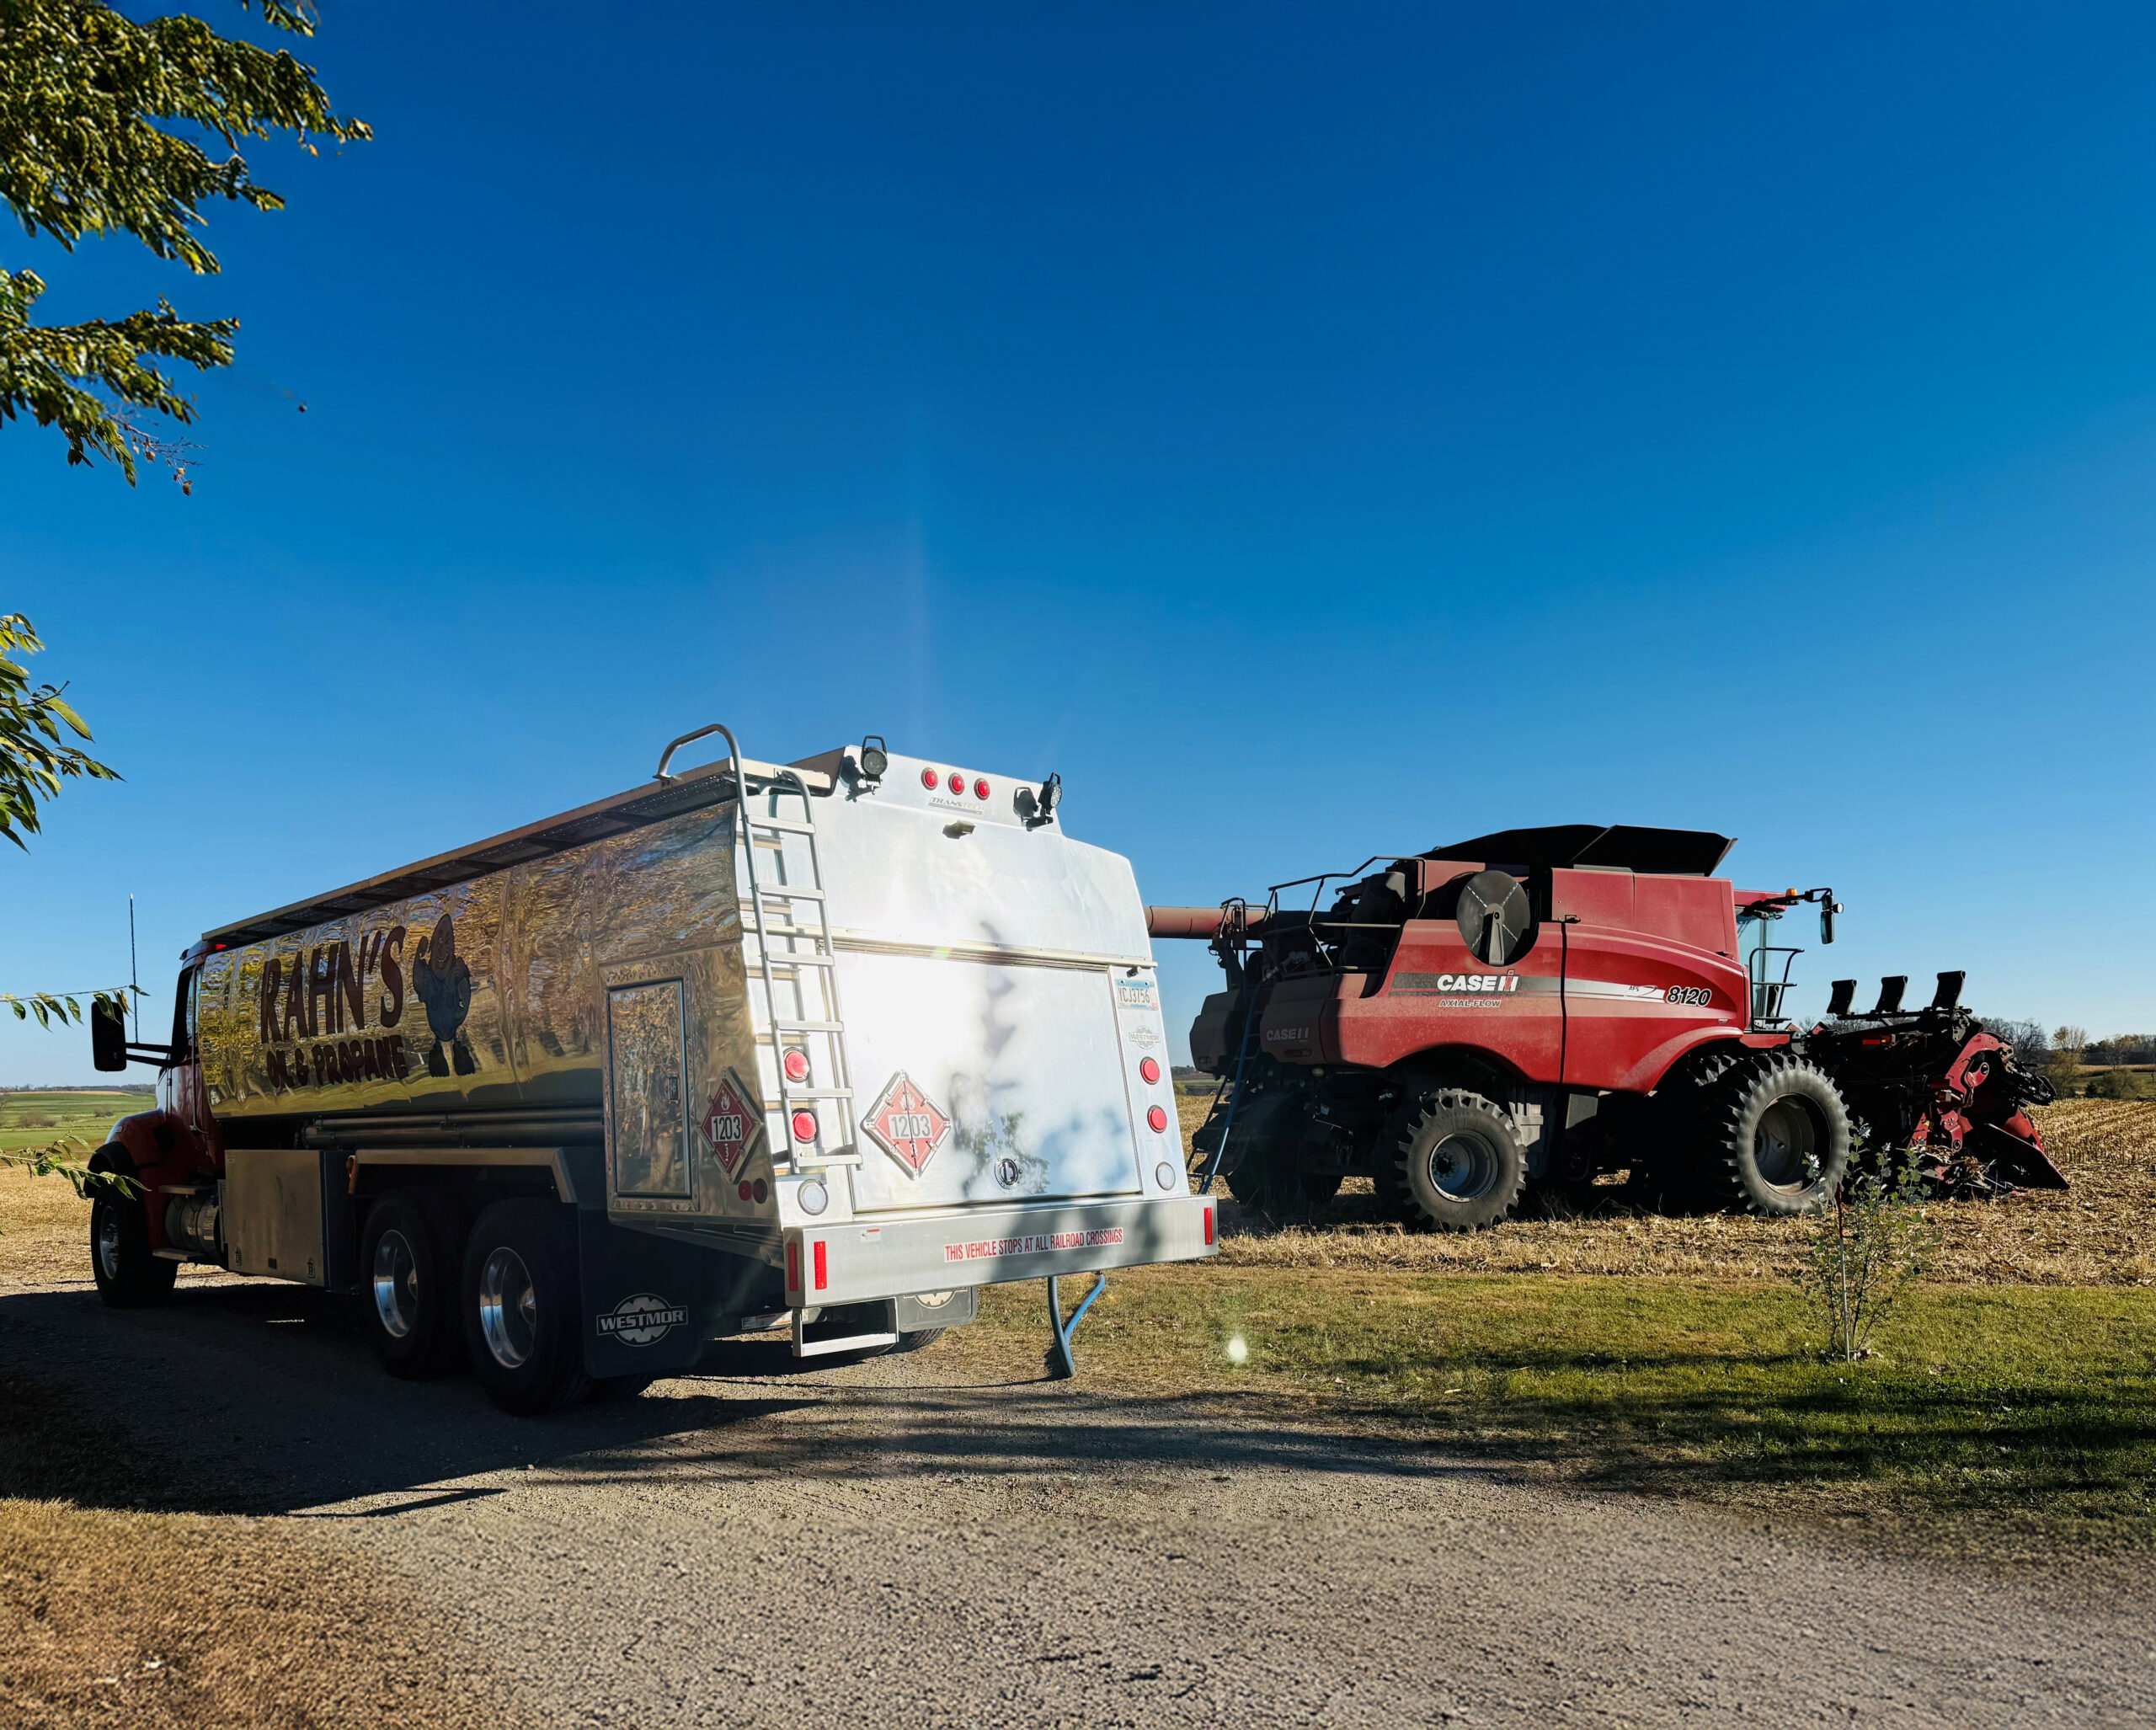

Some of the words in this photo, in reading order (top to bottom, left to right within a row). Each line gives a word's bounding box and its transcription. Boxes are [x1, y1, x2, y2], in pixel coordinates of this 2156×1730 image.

[261, 926, 406, 1044] RAHN'S
[1437, 974, 1497, 991] CASE
[1438, 999, 1502, 1008] AXIAL-FLOW
[1667, 985, 1712, 1007] 8120
[1266, 1028, 1296, 1042] CASE
[296, 1048, 309, 1086] &
[312, 1035, 409, 1085] PROPANE
[713, 1115, 741, 1140] 1203
[891, 1114, 931, 1138] 1203
[945, 1244, 963, 1261] THIS
[966, 1241, 997, 1258] VEHICLE
[999, 1238, 1022, 1255] STOPS
[1024, 1236, 1033, 1252] AT
[1036, 1236, 1049, 1251] ALL
[1050, 1232, 1084, 1249] RAILROAD
[1086, 1228, 1123, 1246] CROSSINGS
[600, 1310, 684, 1331] WESTMOR
